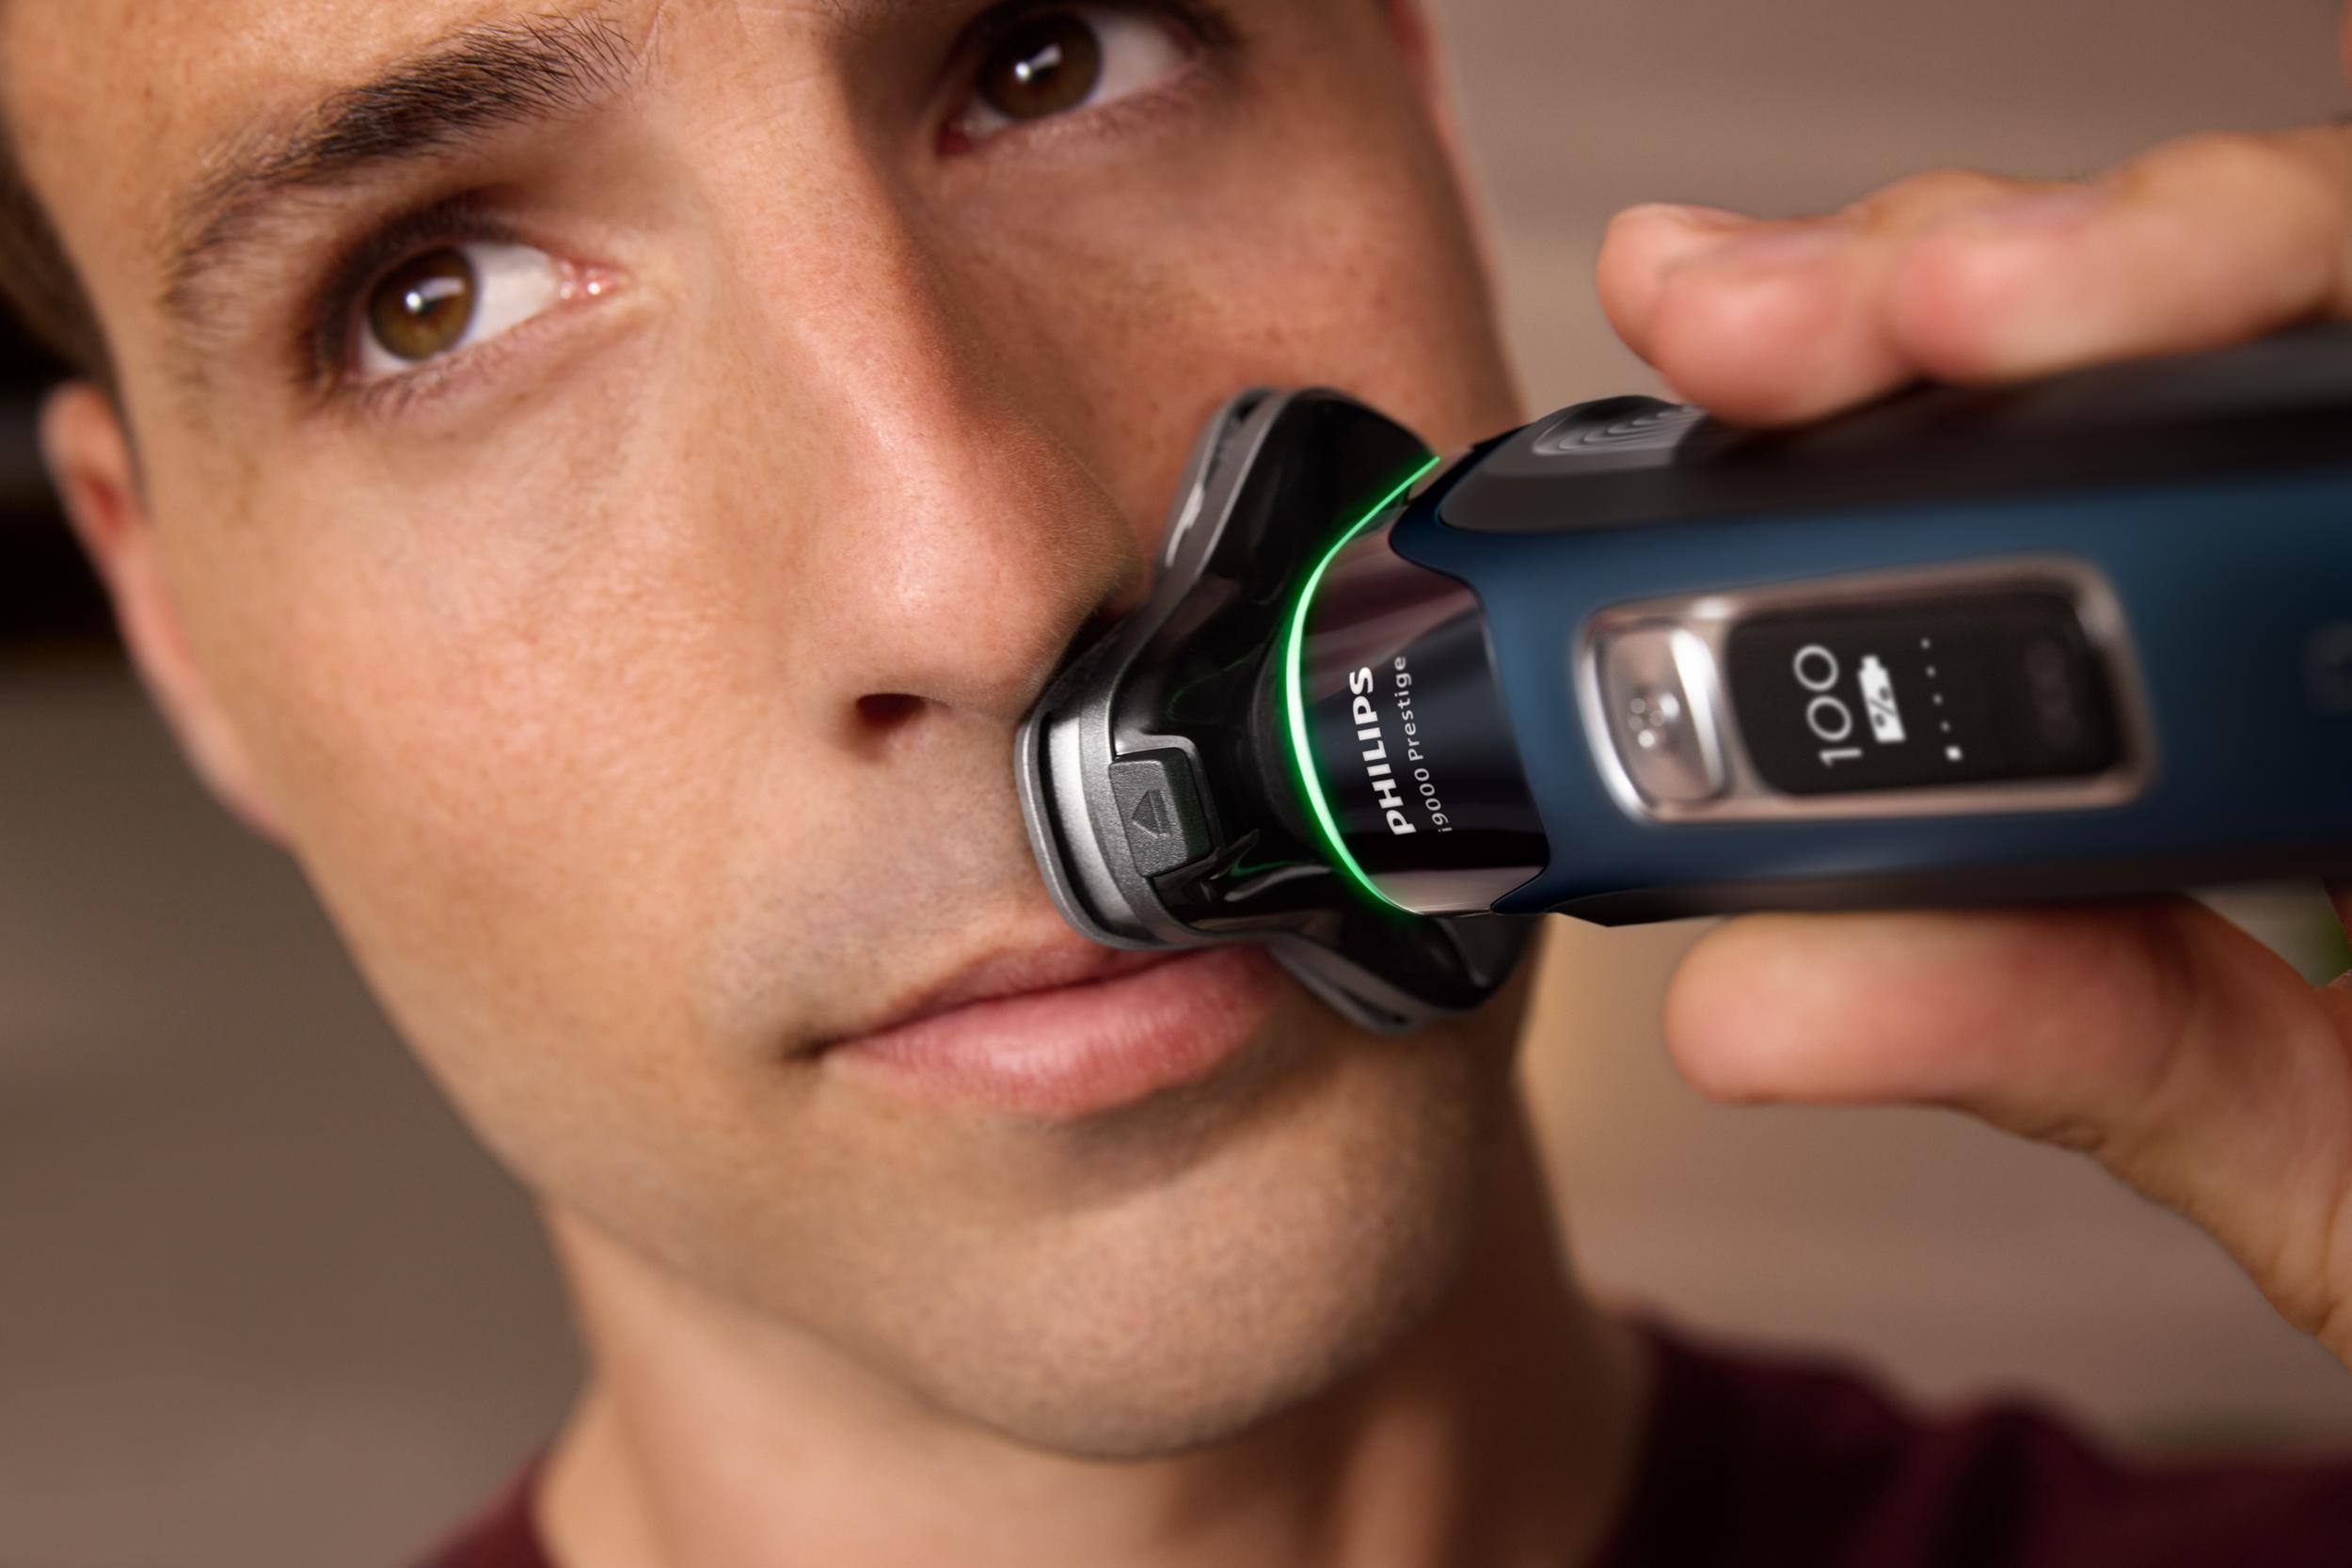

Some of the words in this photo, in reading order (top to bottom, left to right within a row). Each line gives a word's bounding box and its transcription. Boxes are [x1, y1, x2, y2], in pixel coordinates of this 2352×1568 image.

[1349, 666, 1417, 835] PHILIPS
[1393, 656, 1423, 761] Prestige
[1793, 644, 1863, 767] 100
[1868, 687, 1897, 728] %
[1414, 768, 1453, 833] i9000
